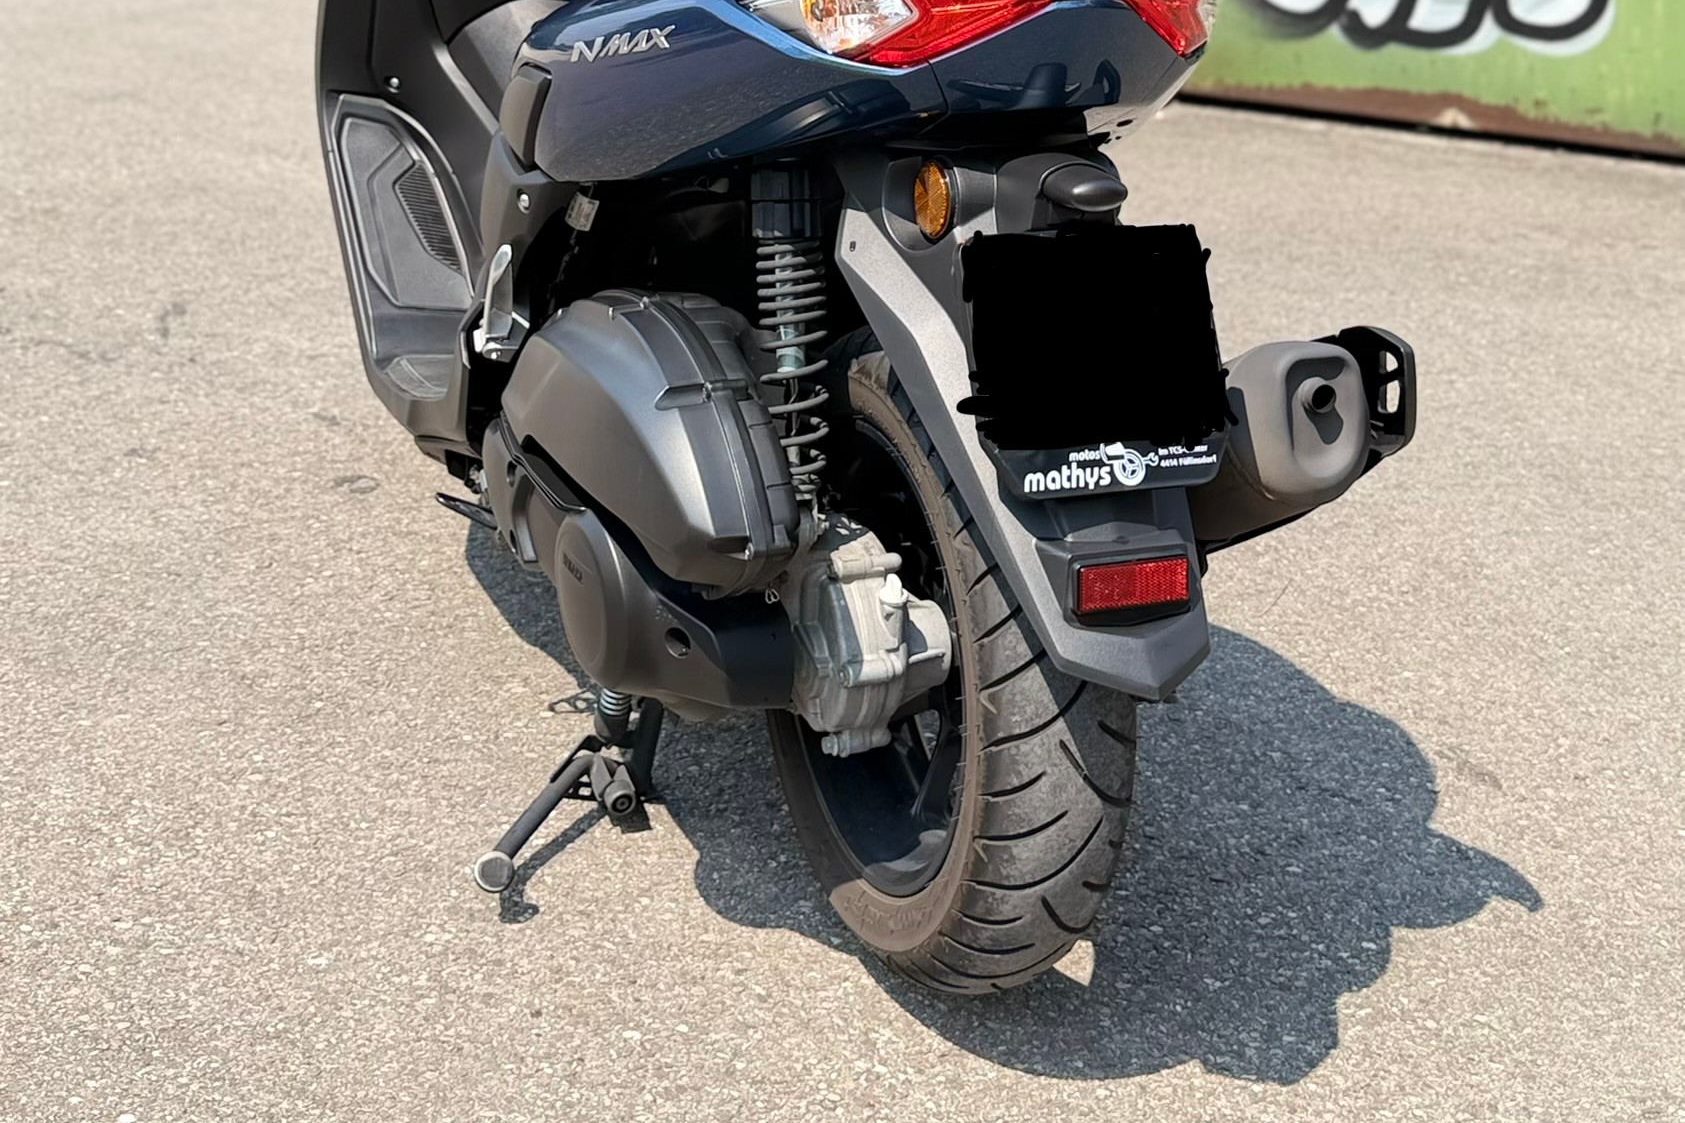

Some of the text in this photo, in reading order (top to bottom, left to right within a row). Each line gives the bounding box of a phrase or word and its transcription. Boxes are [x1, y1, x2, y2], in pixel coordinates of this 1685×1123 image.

[570, 24, 676, 63] NMAX
[1068, 448, 1101, 462] motos
[1024, 461, 1112, 493] mathys
